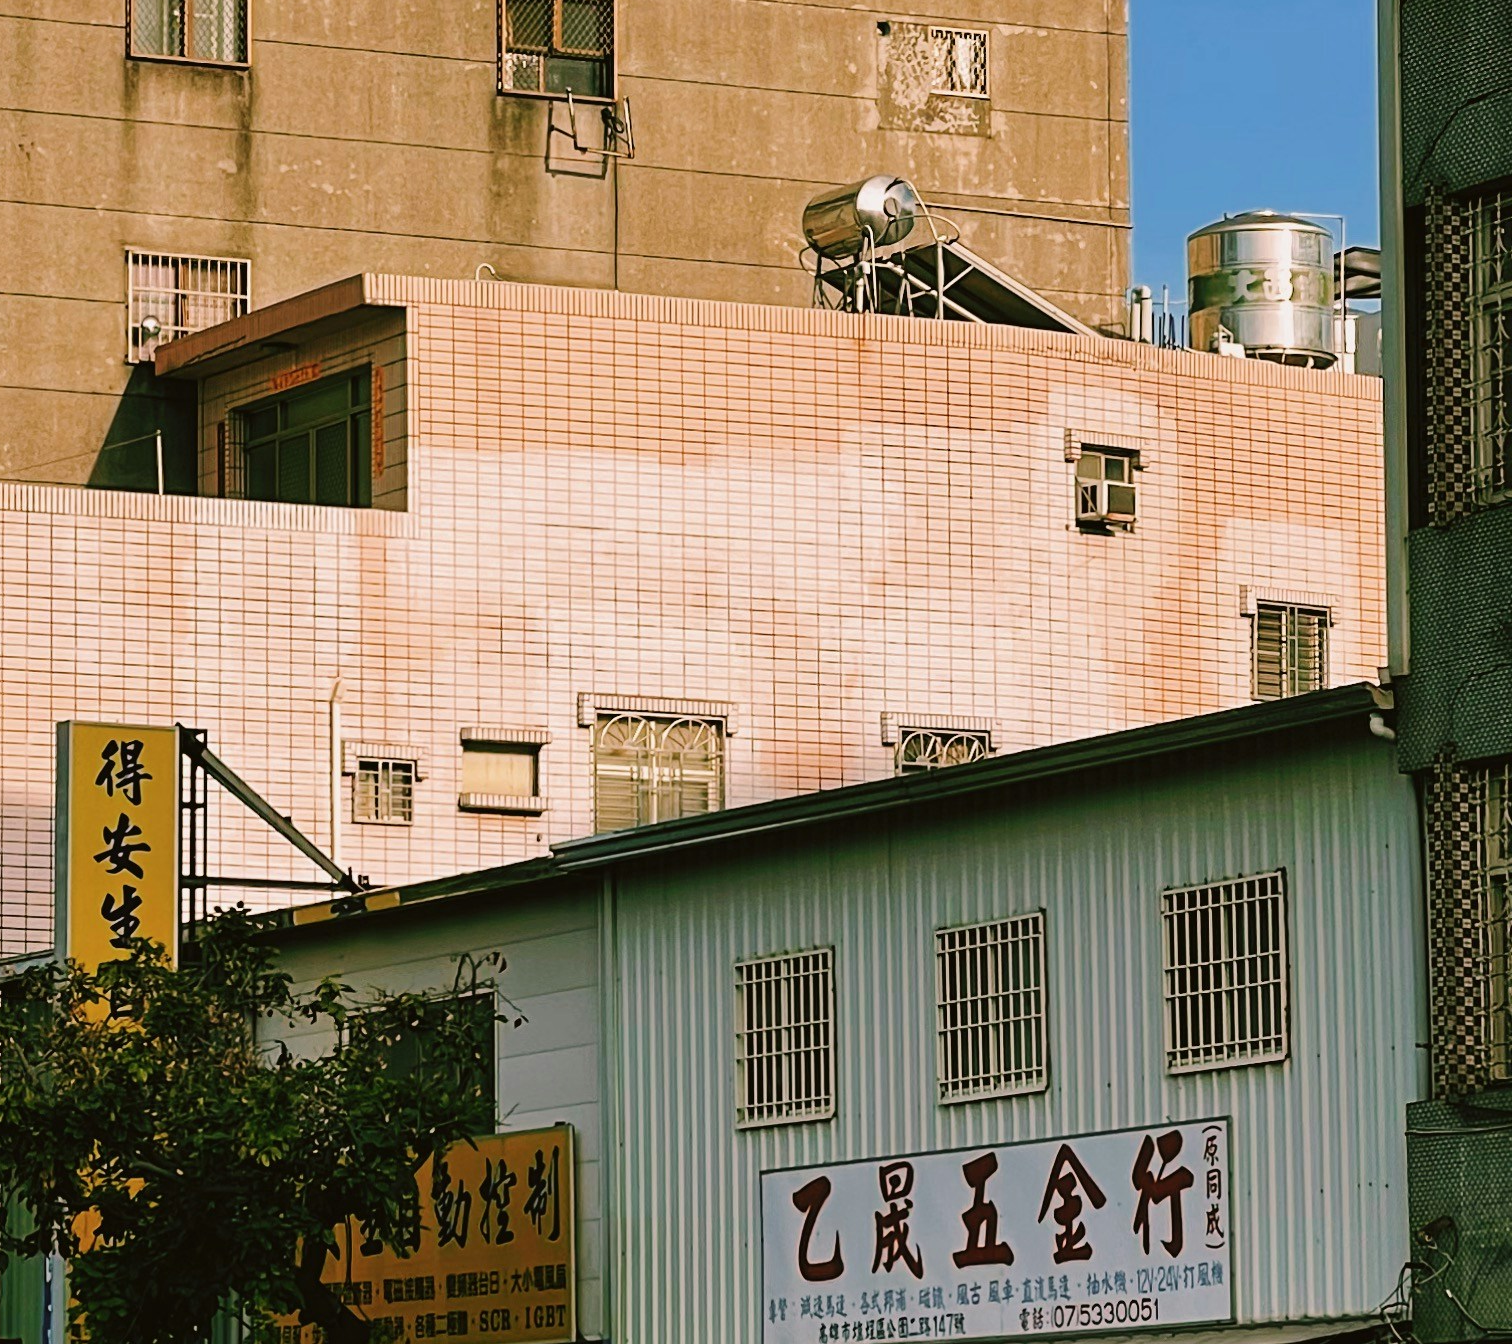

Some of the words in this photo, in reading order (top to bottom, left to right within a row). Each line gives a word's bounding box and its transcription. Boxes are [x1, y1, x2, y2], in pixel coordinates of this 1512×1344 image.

[791, 1128, 1195, 1282] 乙晟五金行
